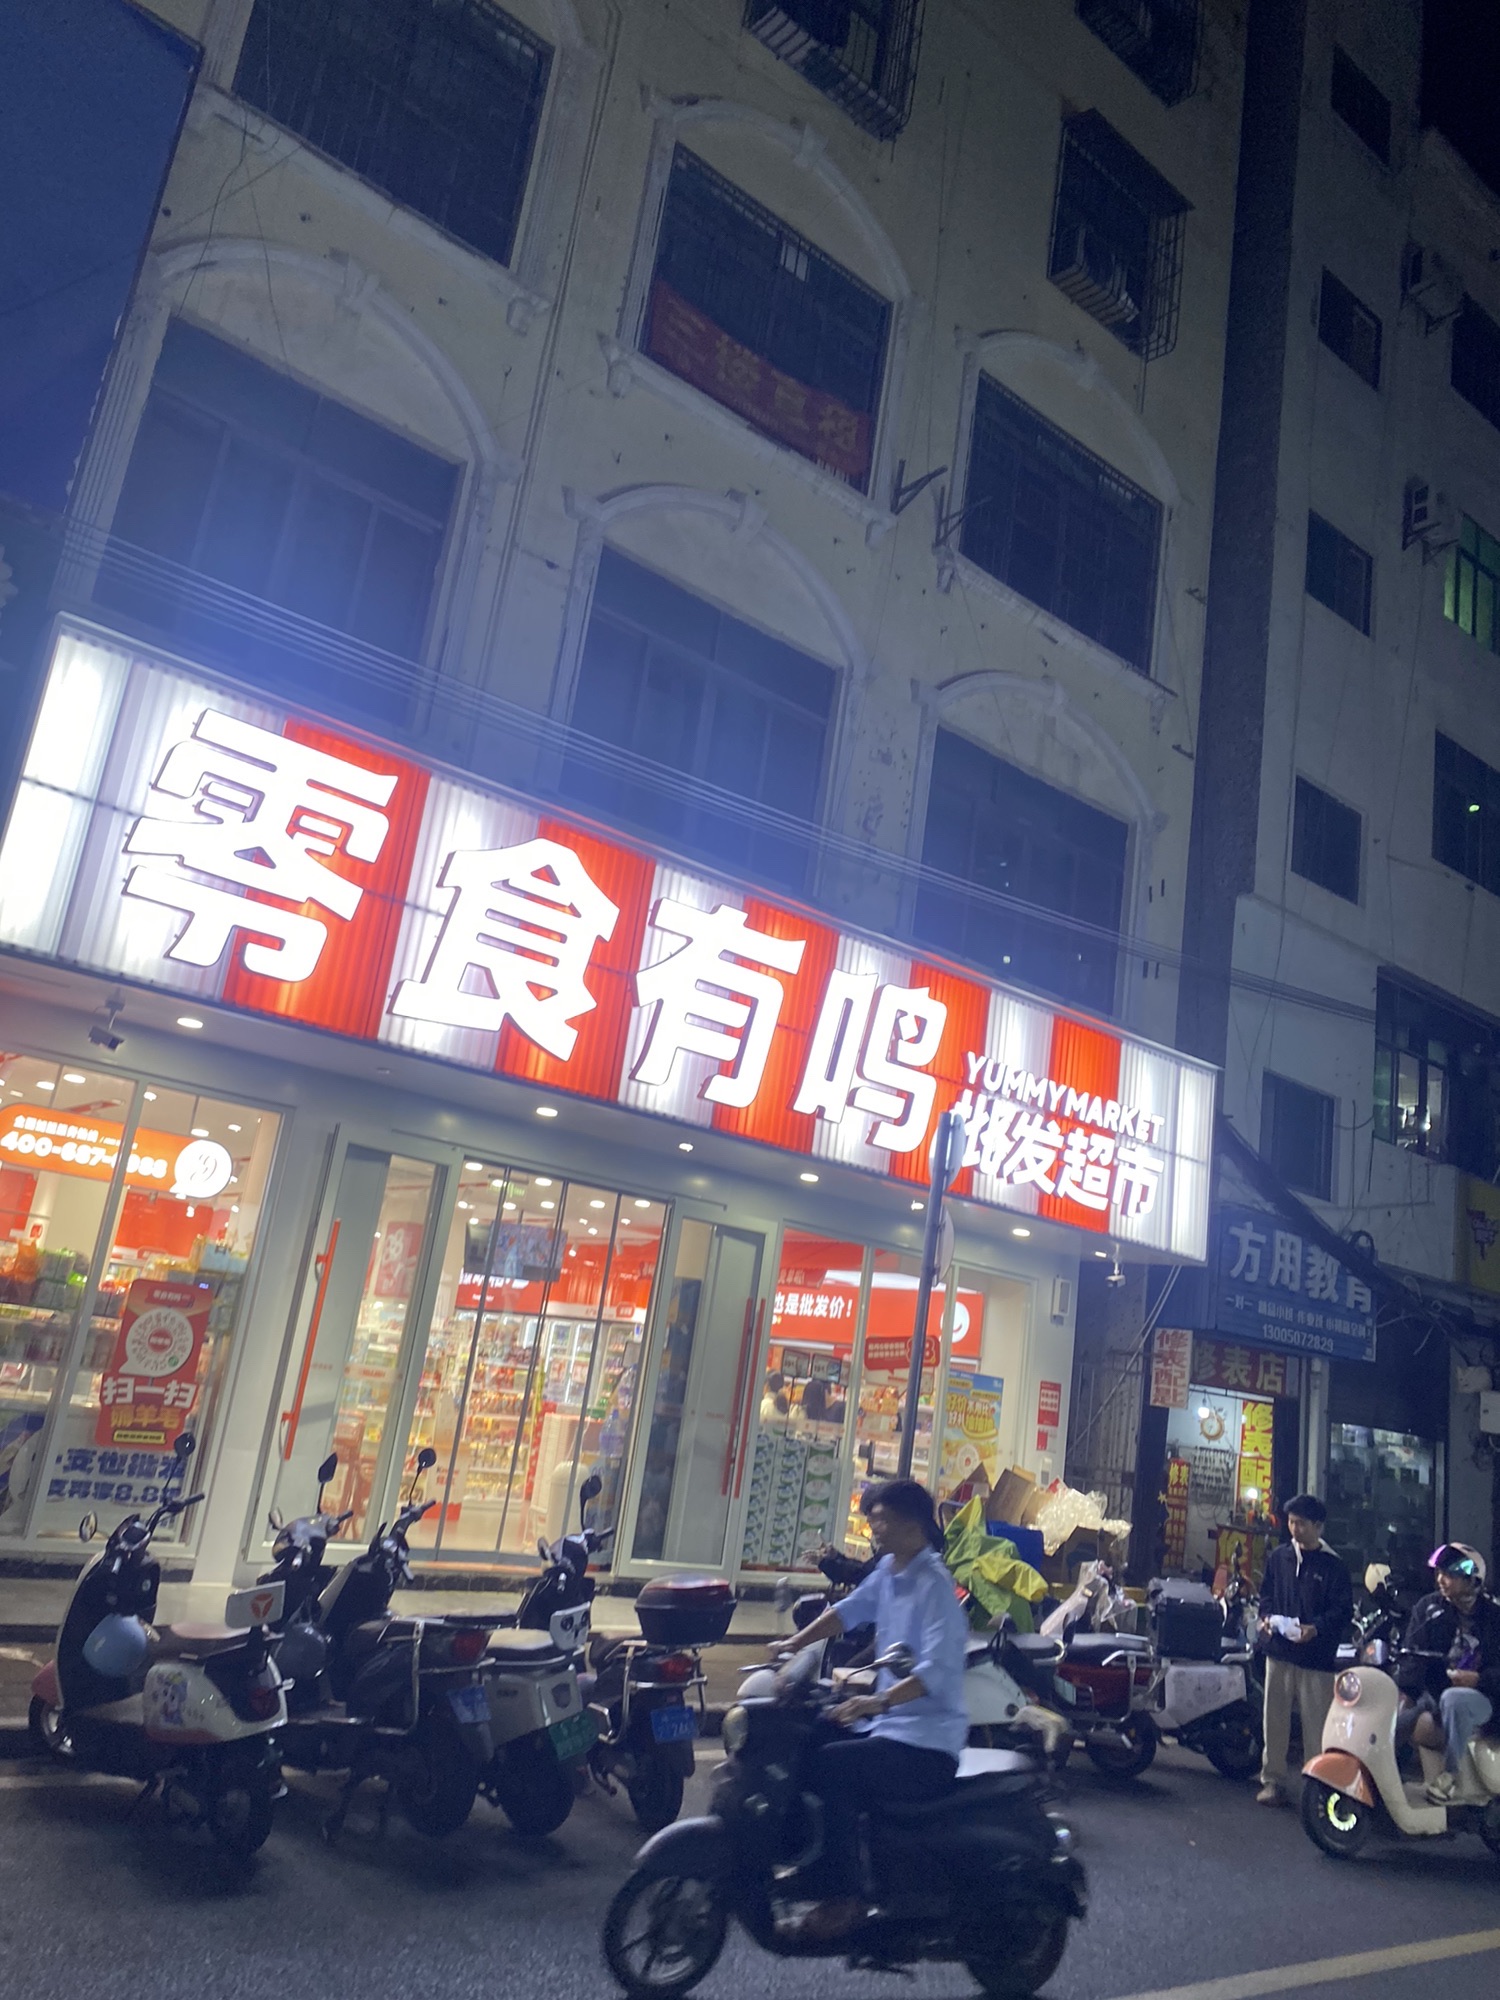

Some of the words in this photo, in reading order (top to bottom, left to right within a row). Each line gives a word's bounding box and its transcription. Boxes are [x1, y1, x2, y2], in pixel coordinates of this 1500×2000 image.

[121, 706, 949, 1153] 零食有鸣
[950, 1089, 1166, 1220] 批发超市
[1262, 1323, 1334, 1353] 13005072829
[103, 1376, 197, 1408] 扫一扫
[1193, 1340, 1285, 1394] 修表店
